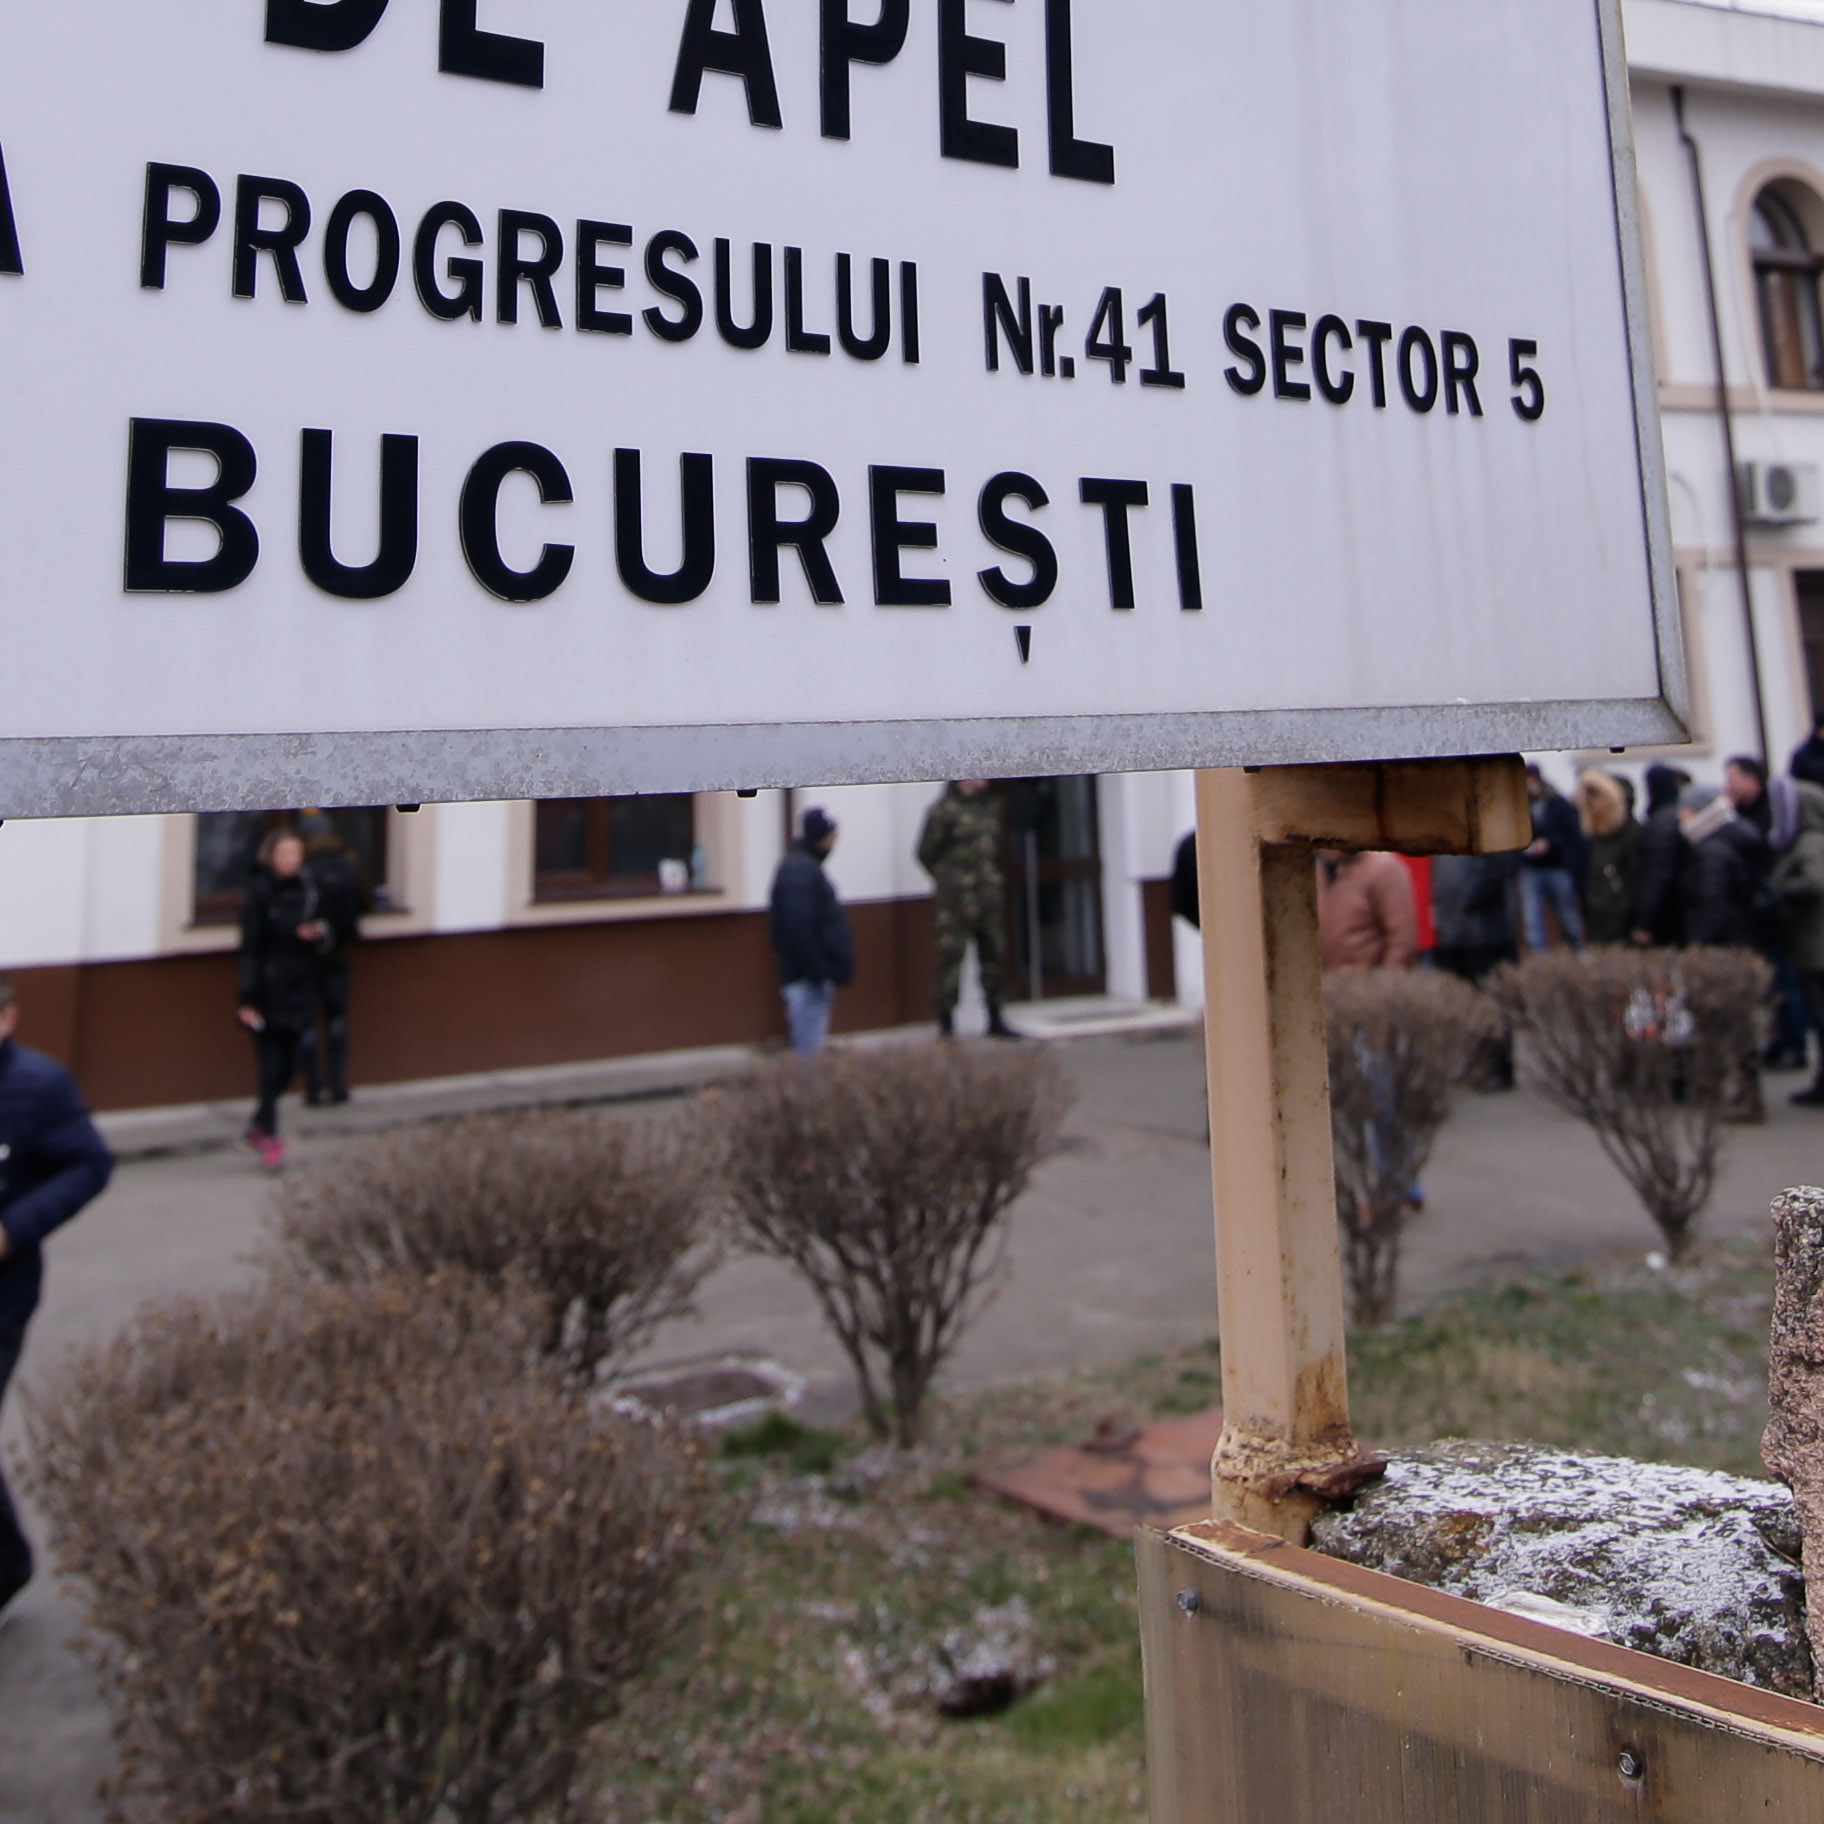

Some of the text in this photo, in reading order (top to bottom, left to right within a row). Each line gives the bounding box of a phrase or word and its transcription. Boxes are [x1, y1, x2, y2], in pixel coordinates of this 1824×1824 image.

[139, 161, 920, 365] PROGRESULUI
[982, 272, 1186, 390] Nr.41
[1223, 302, 1484, 418] SECTOR
[1509, 338, 1545, 424] 5
